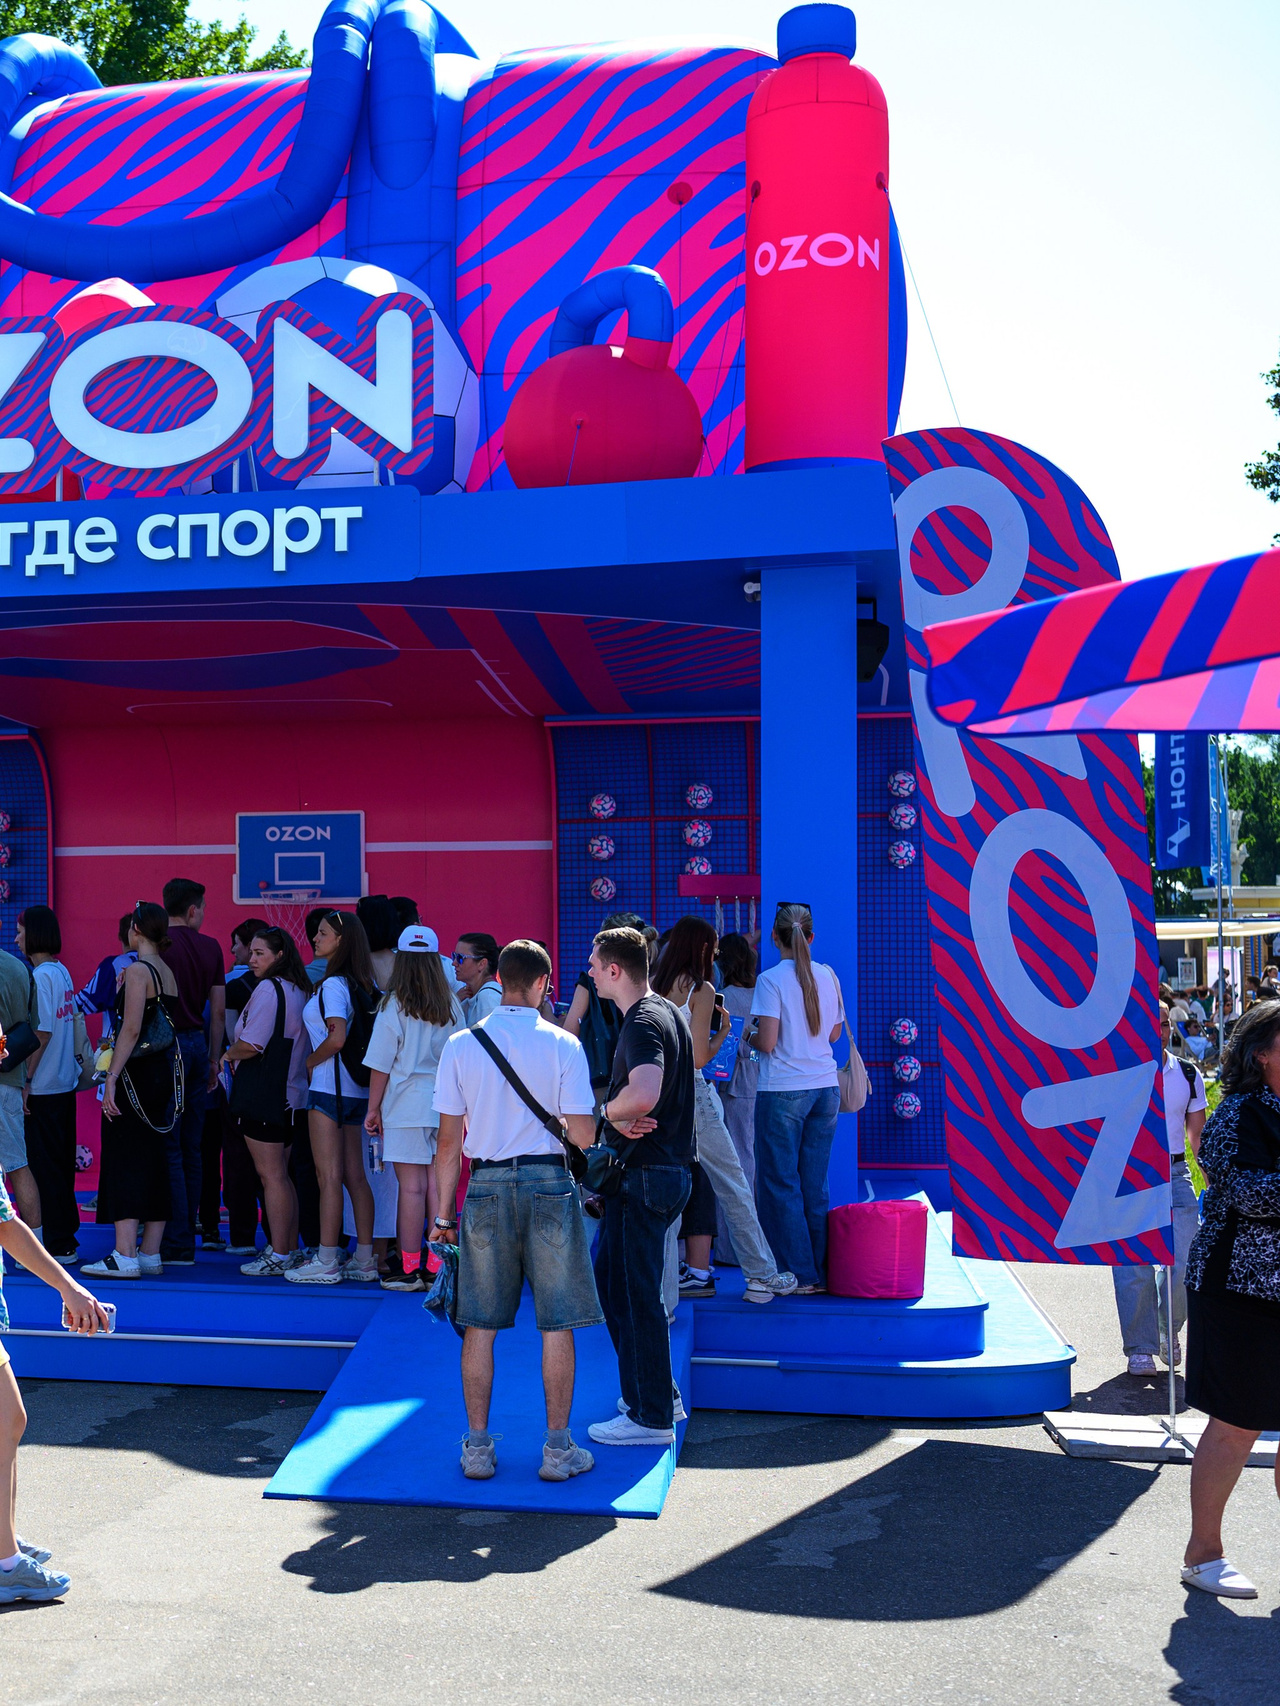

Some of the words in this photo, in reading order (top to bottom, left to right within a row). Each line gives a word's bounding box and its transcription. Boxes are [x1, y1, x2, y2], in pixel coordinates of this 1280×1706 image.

[754, 232, 880, 276] OZON
[136, 505, 363, 572] спорт
[265, 825, 331, 842] OZON
